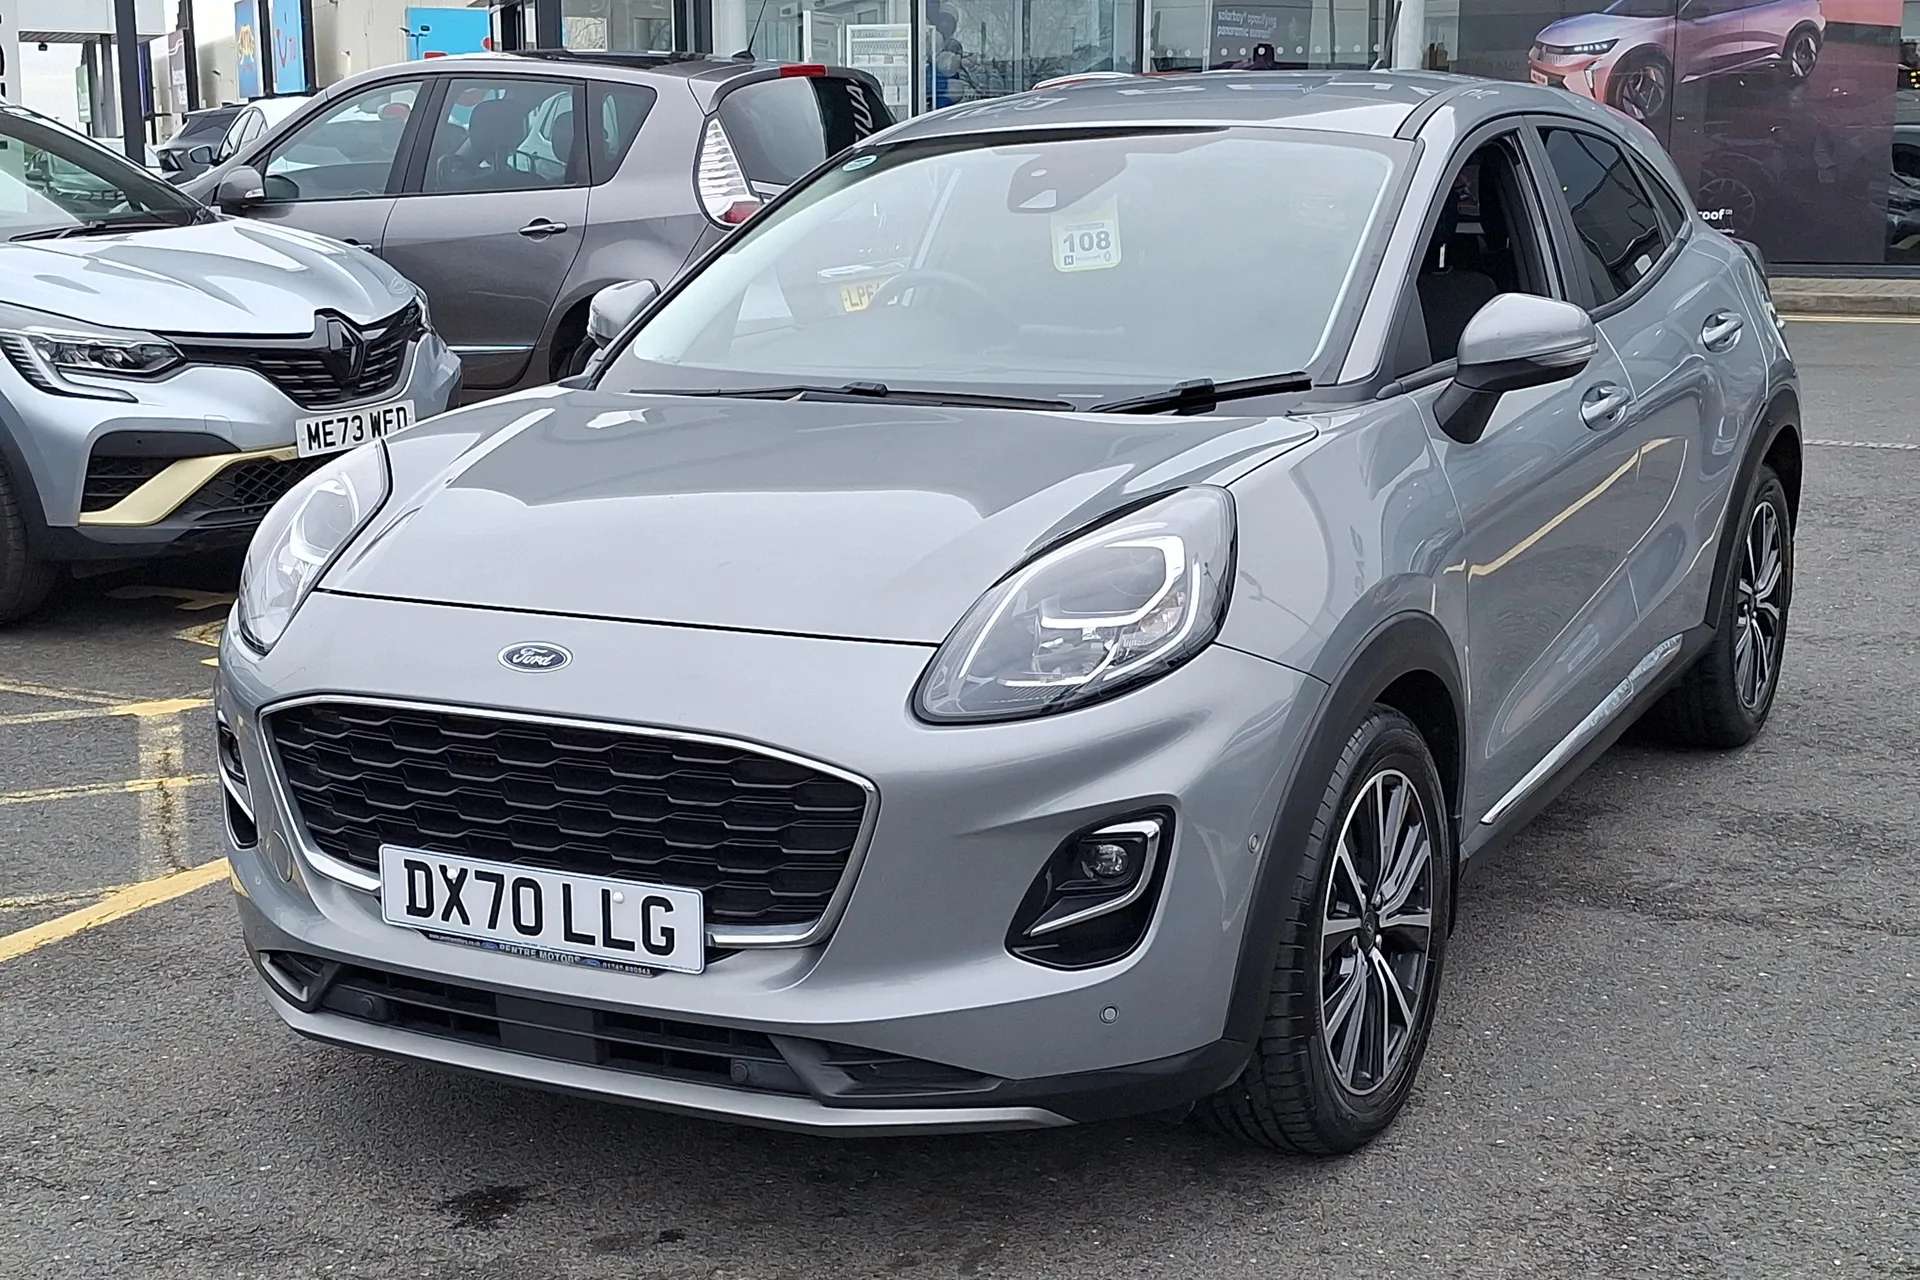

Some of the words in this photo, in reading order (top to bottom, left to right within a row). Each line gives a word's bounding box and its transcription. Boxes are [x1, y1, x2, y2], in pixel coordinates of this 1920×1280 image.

[1063, 230, 1112, 253] 108
[306, 414, 365, 451] ME73
[512, 647, 556, 666] Ford
[403, 858, 543, 937] DX70
[561, 882, 675, 956] LLG
